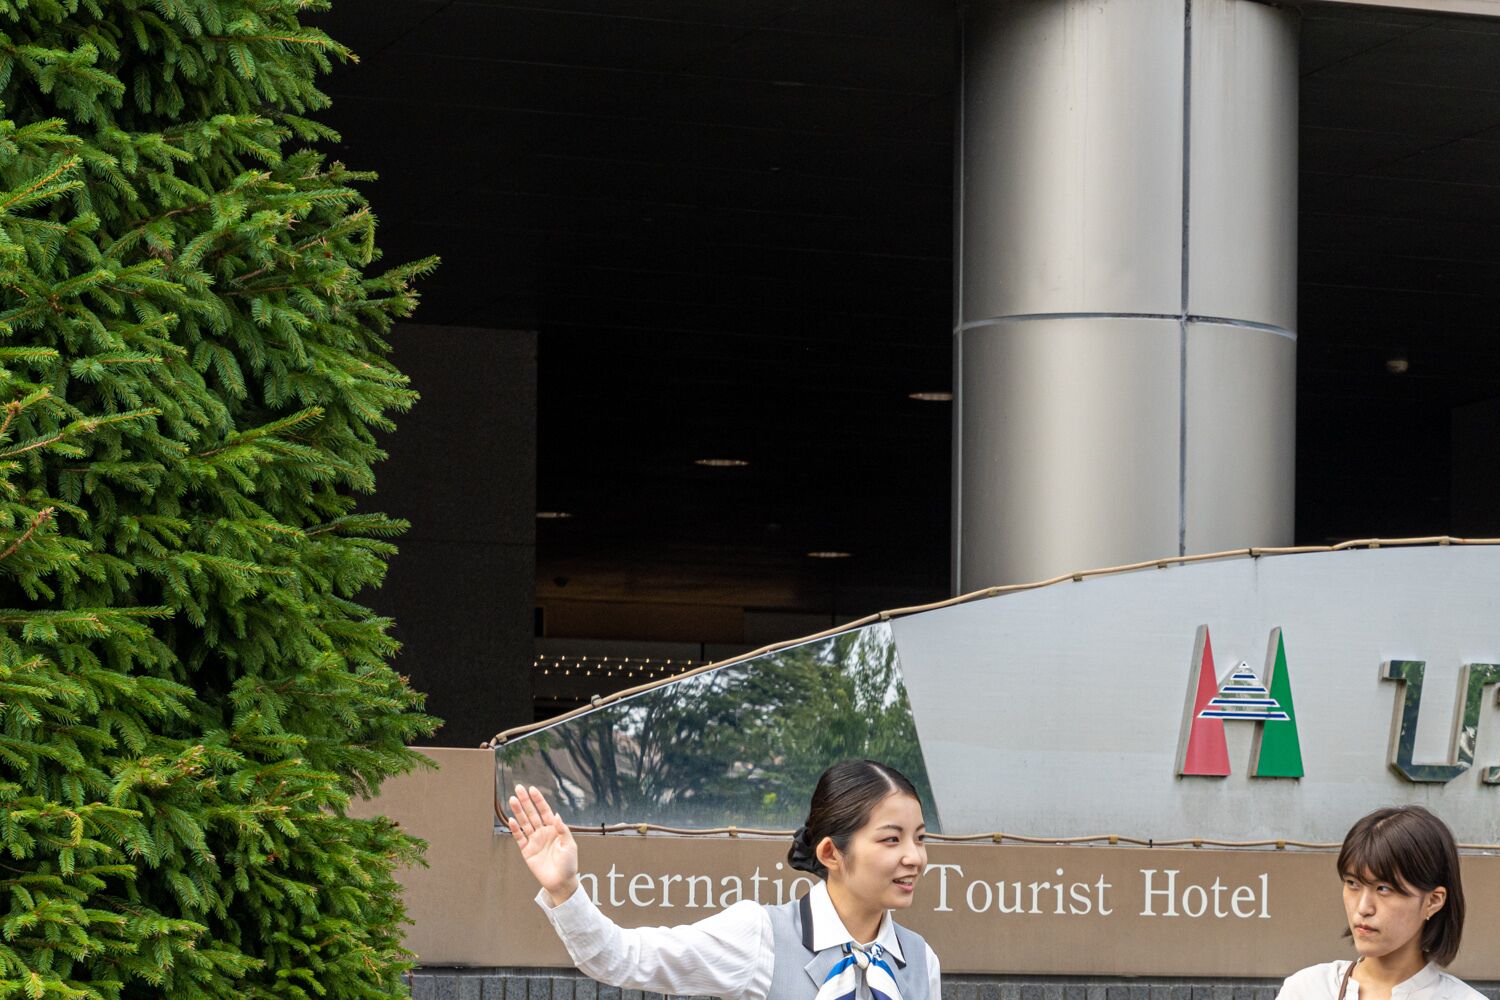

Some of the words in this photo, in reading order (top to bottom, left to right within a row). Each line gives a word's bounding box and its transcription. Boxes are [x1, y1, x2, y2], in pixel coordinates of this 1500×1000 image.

[576, 861, 896, 912] nternatio
[924, 863, 1113, 916] Tourist
[1139, 868, 1272, 919] Hotel
